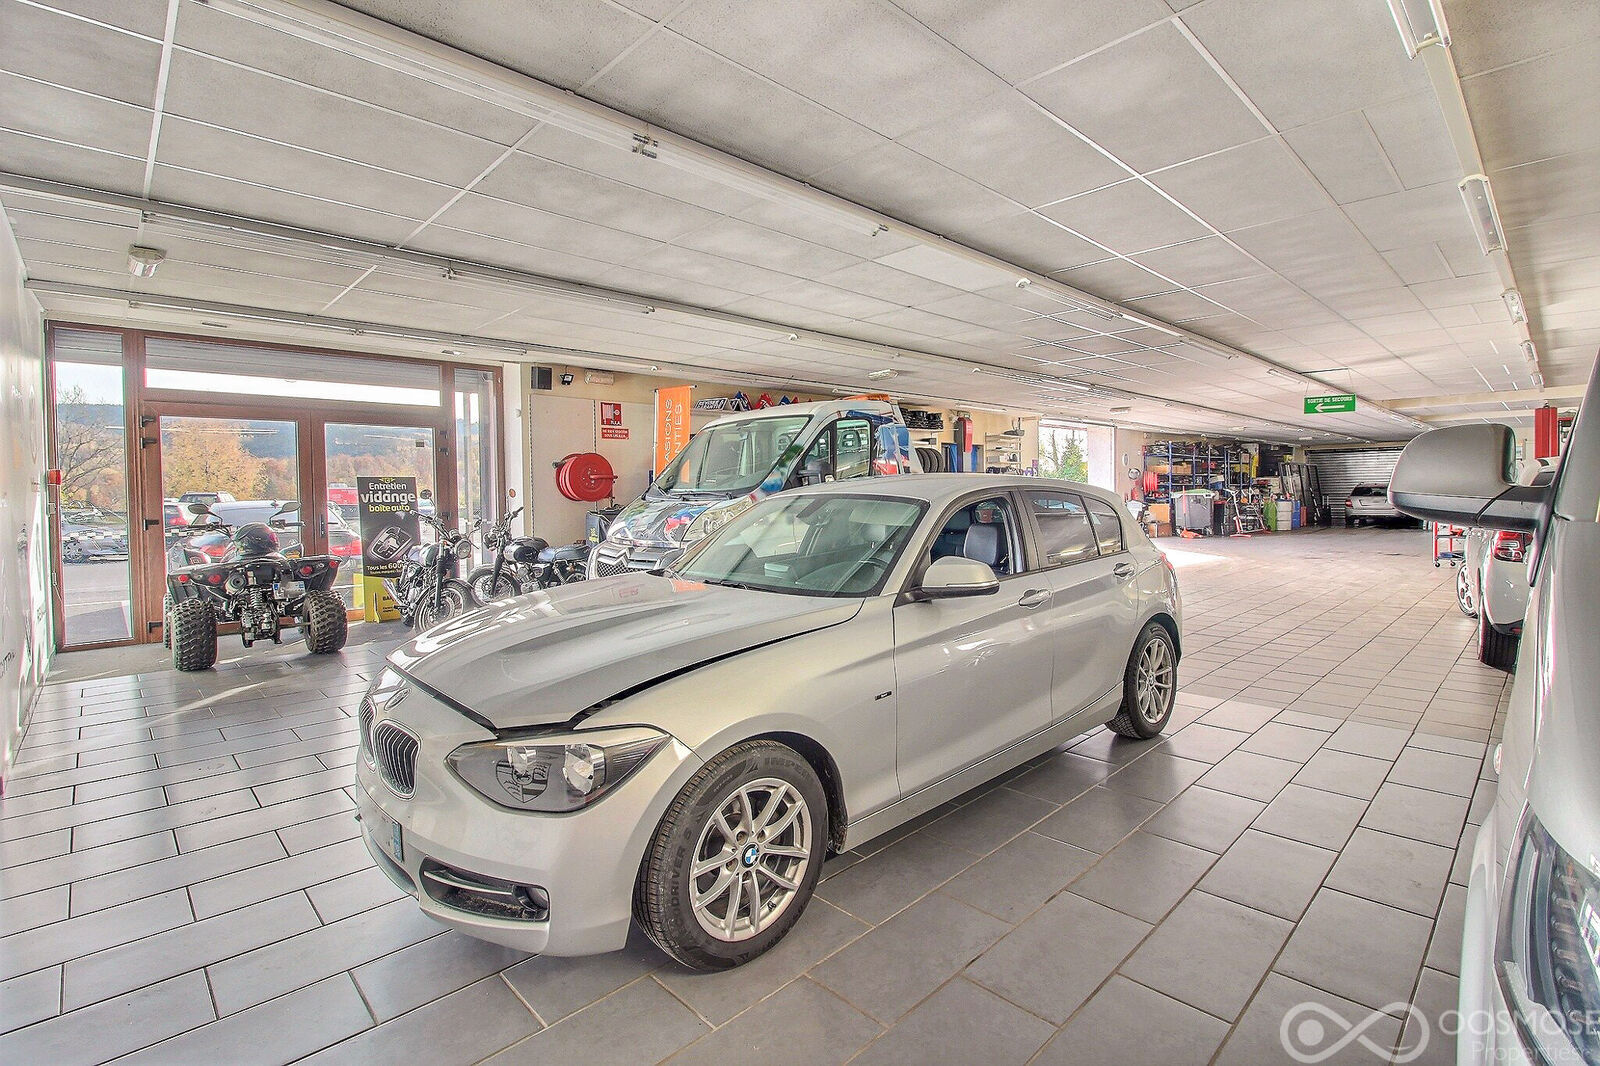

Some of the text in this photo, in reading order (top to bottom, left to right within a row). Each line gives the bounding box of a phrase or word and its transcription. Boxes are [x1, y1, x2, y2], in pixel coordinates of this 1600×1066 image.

[664, 398, 673, 467] ASIONS
[368, 482, 407, 490] Entretien
[361, 490, 417, 505] vidange
